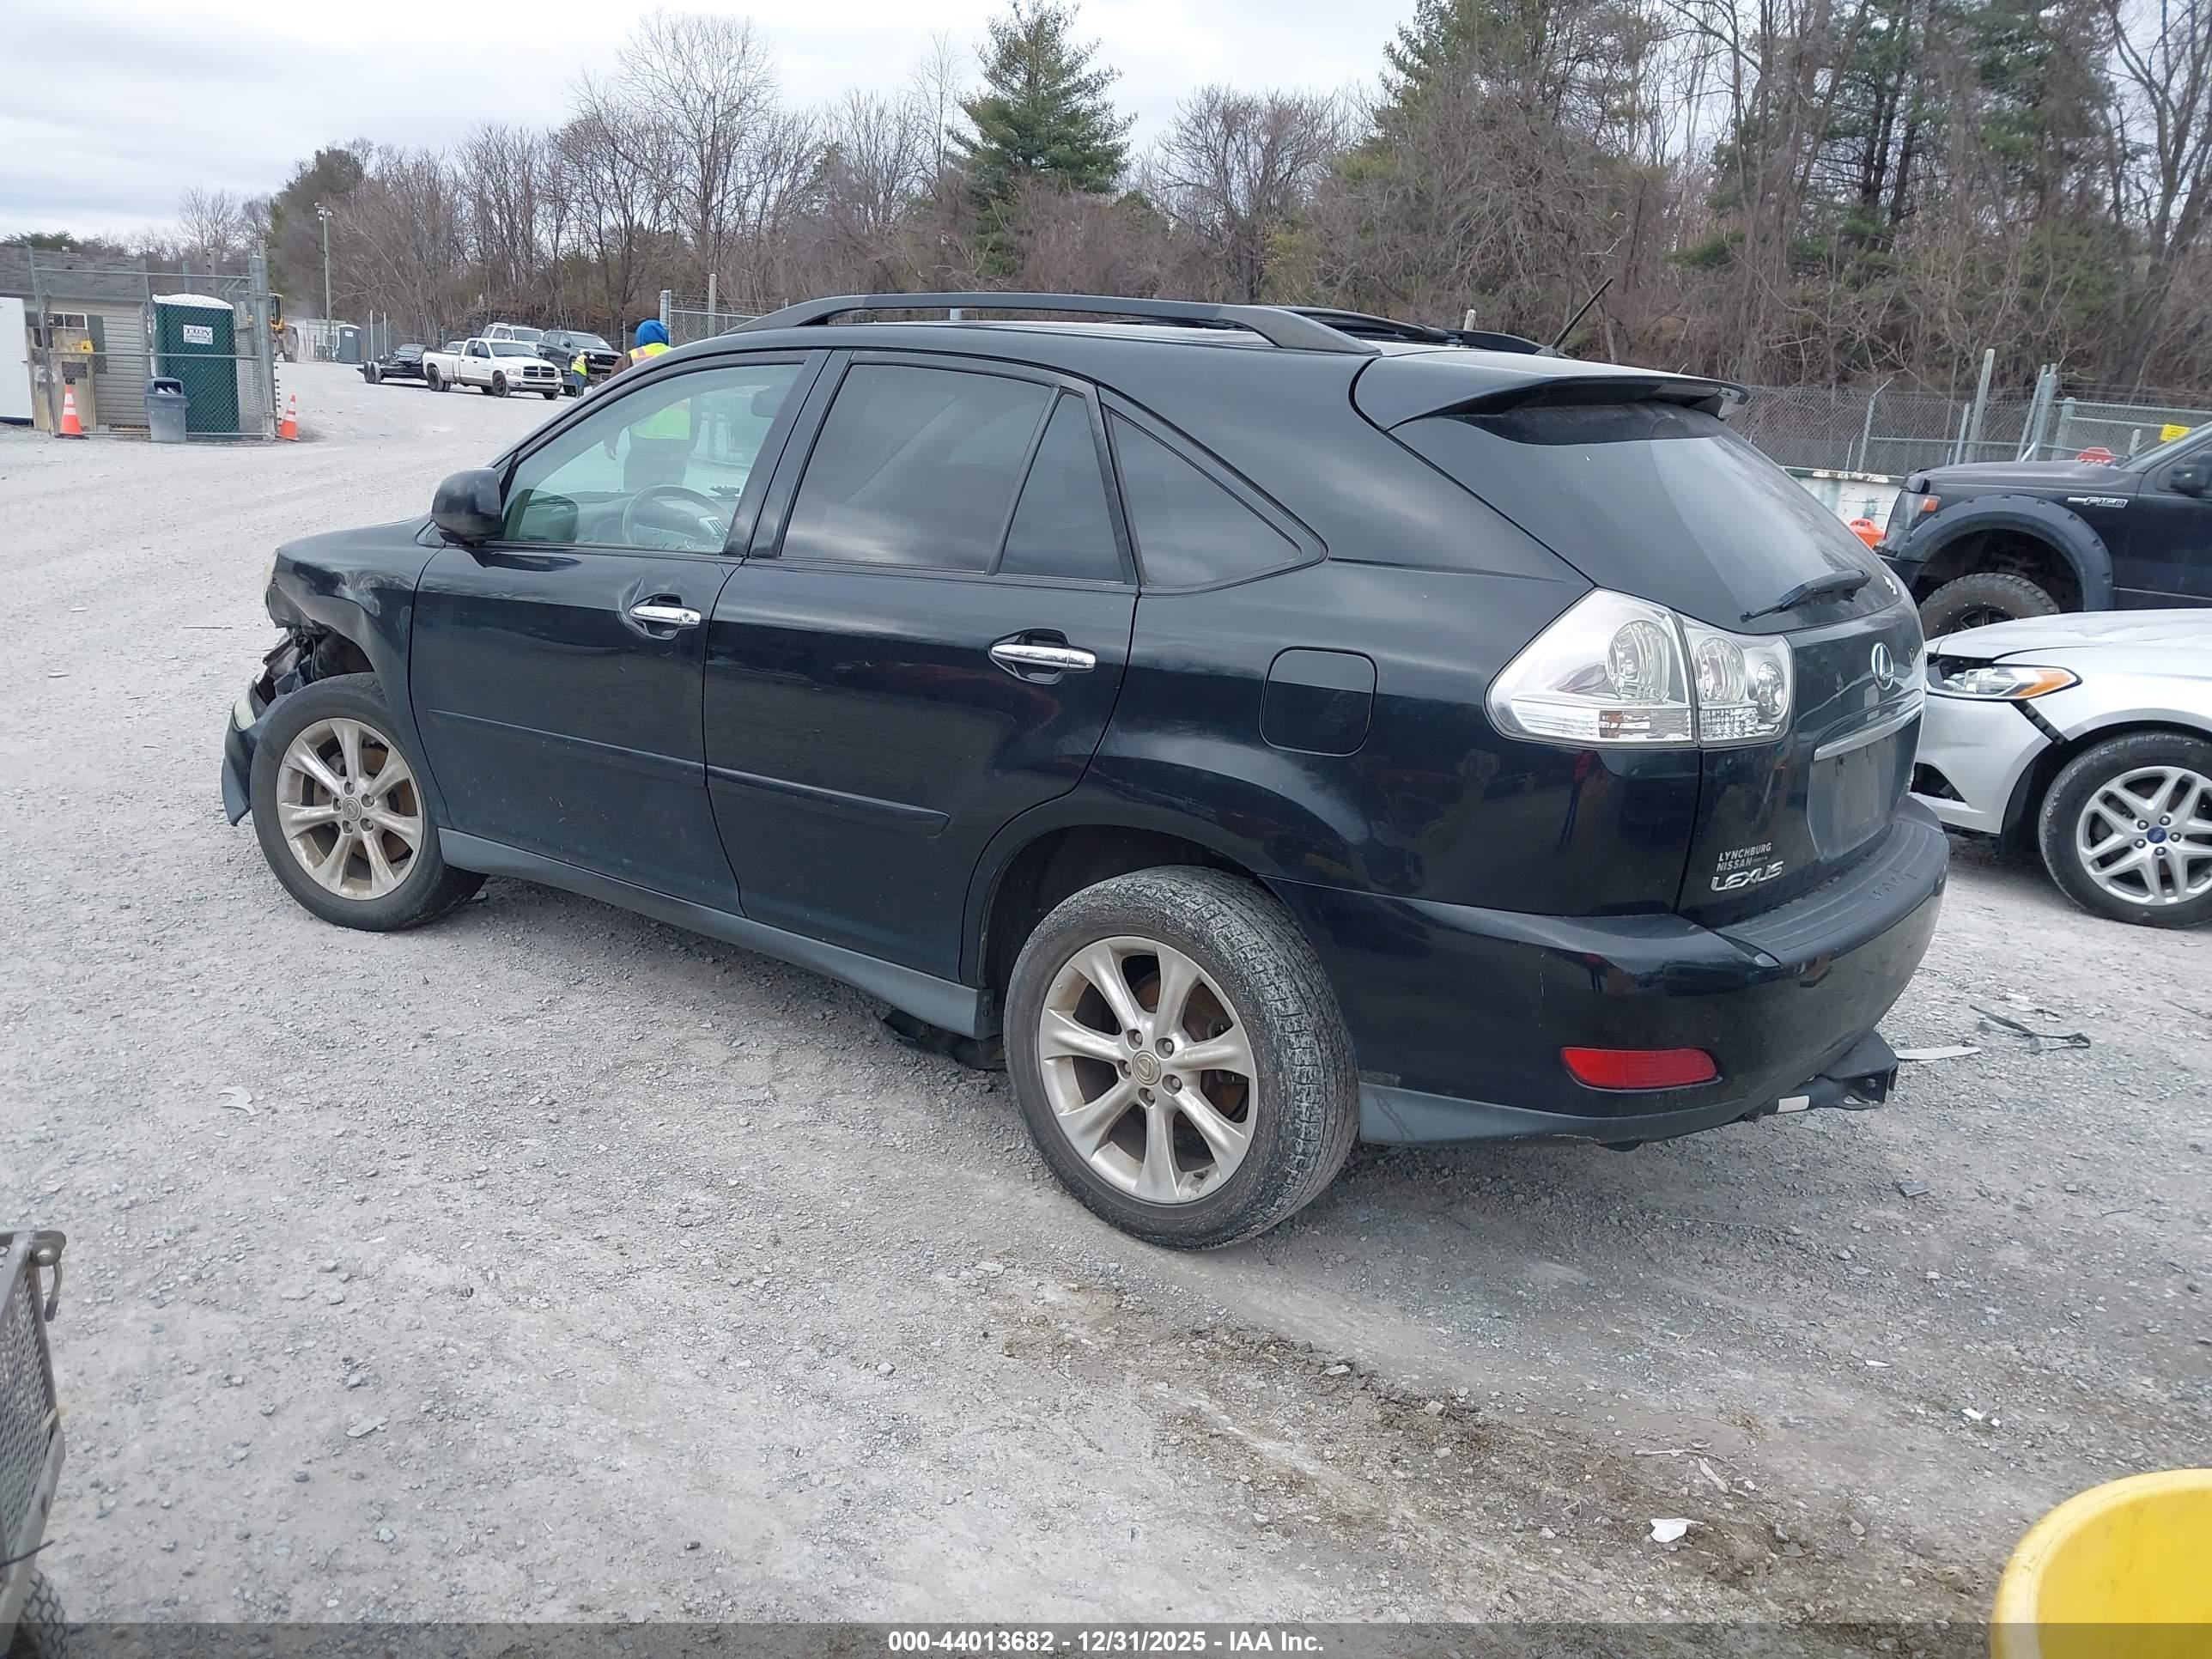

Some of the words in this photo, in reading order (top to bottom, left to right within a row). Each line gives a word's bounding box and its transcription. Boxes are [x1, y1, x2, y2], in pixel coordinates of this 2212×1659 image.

[1718, 842, 1772, 862] LYNCHBURG
[1717, 857, 1753, 872] NISSAN
[1711, 860, 1784, 891] LEXUS
